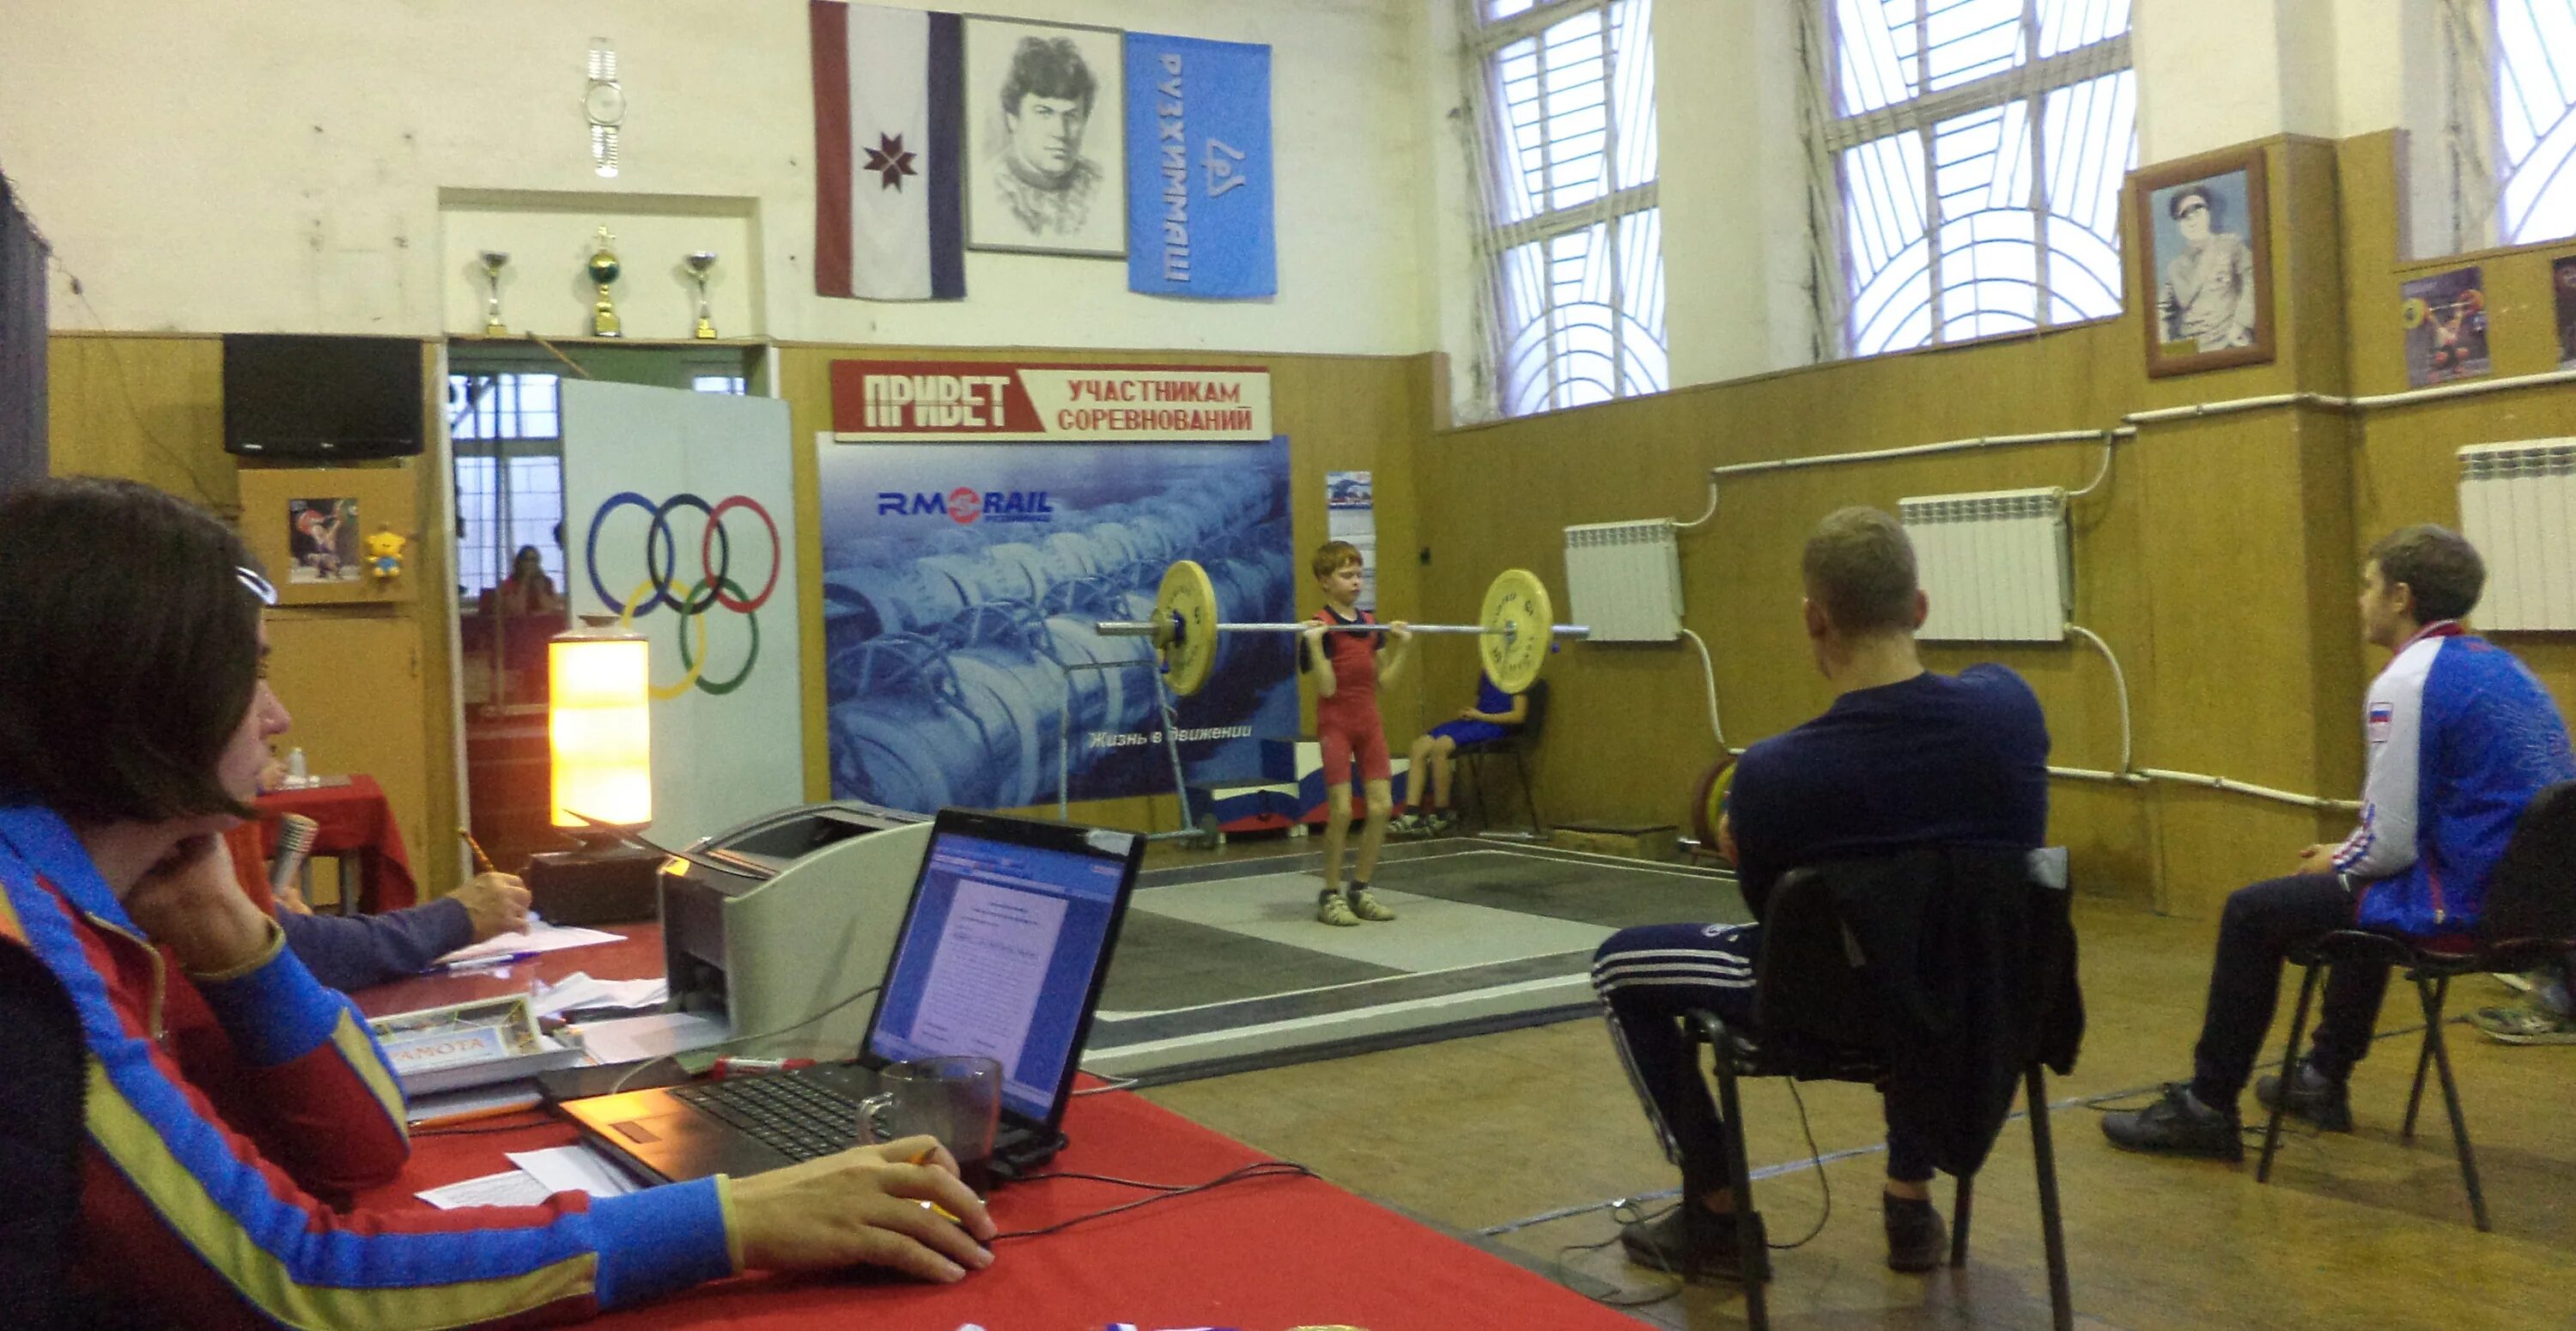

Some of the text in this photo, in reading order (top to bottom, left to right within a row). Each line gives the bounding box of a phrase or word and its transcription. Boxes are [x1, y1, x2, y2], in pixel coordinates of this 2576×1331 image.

[1157, 53, 1191, 282] РУЗХИММАШ
[862, 374, 1011, 427] ПРИВЕТ
[1069, 379, 1242, 403] УЧАСТНИКАМ
[1058, 406, 1255, 431] СОРЕВНОВАНИЙ
[983, 491, 1054, 514] RAIL
[1089, 725, 1253, 747] Жизнь в движении
